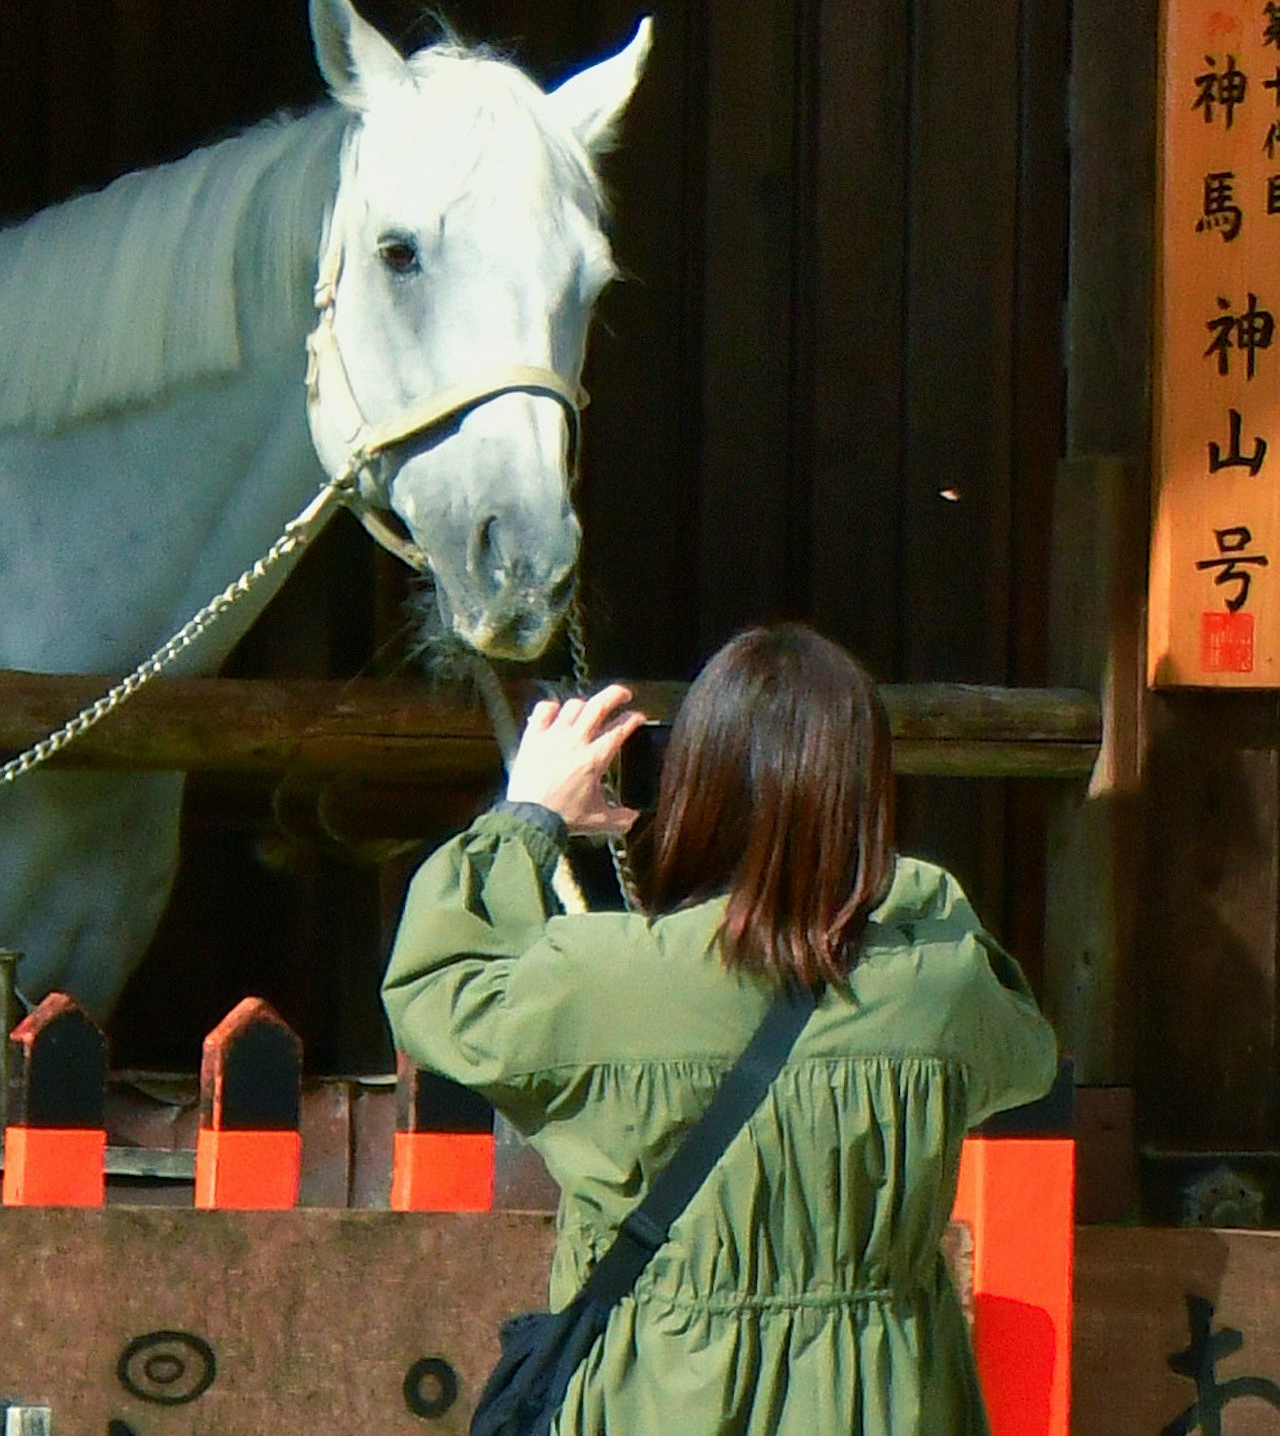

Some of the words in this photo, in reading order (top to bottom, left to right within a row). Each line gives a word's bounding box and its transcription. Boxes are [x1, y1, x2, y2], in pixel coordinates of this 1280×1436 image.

[1190, 54, 1275, 613] 神馬神山号
